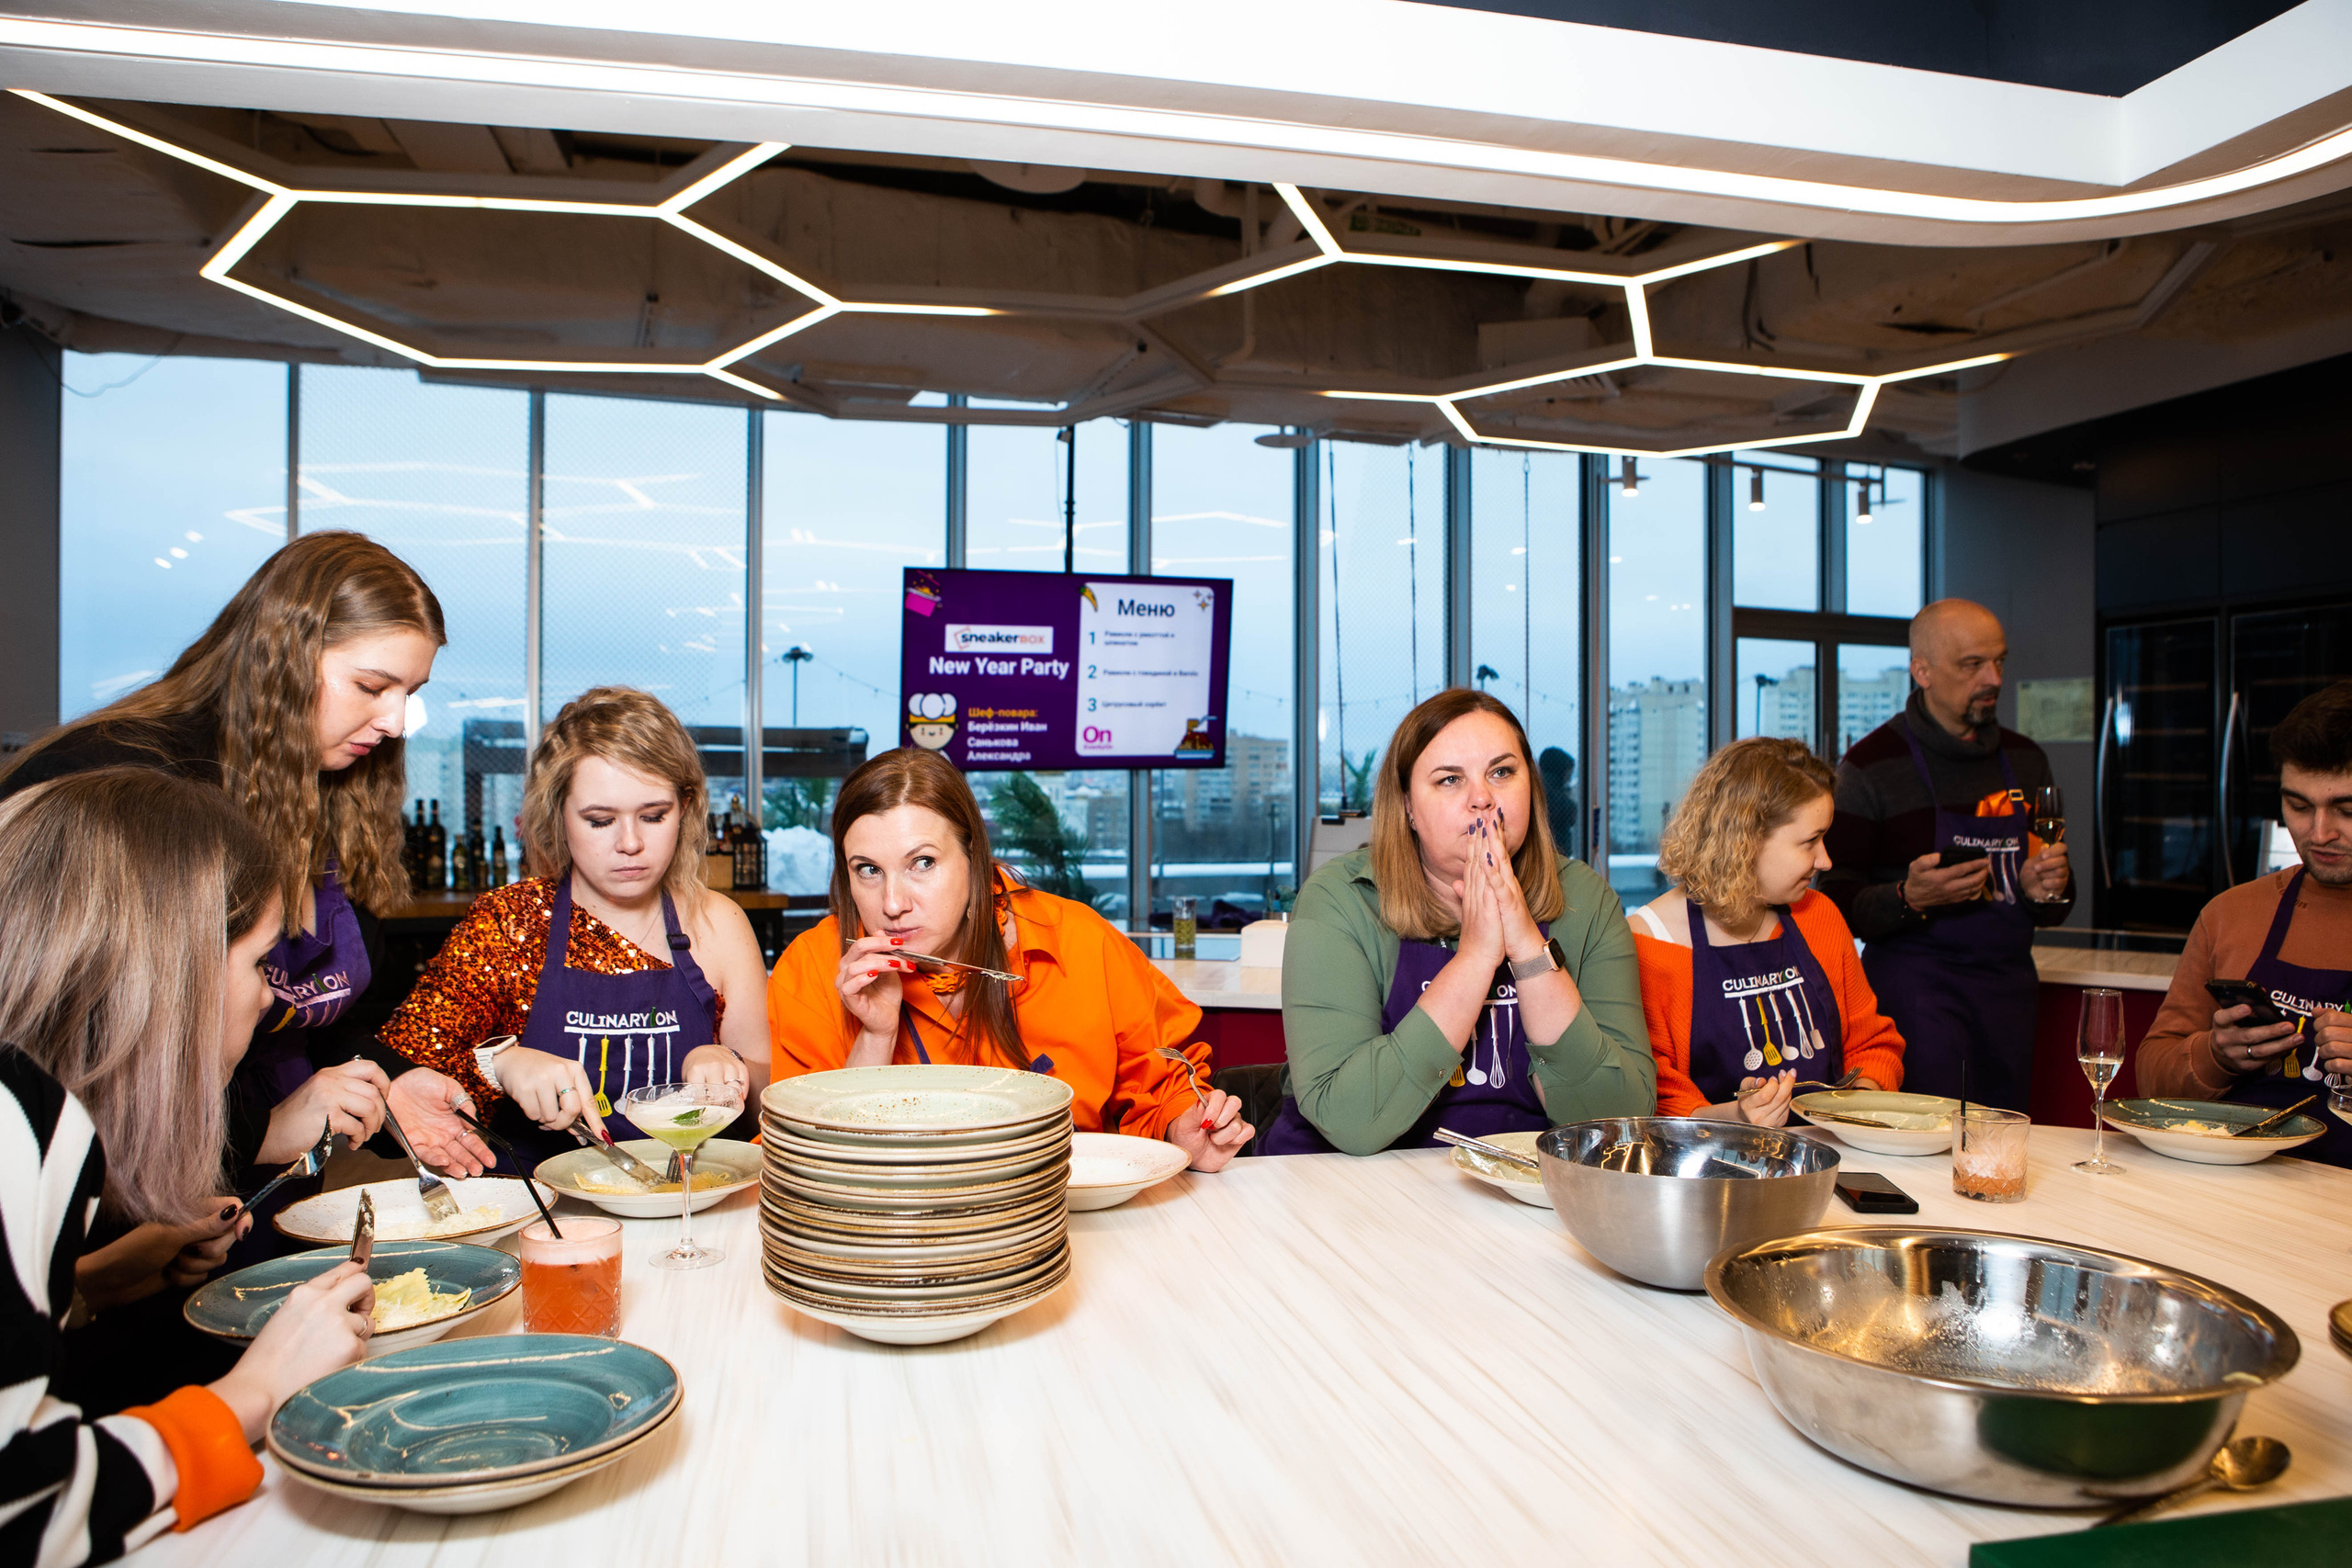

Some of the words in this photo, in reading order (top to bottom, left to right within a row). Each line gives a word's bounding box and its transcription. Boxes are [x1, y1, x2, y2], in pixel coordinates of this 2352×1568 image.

[1117, 599, 1175, 617] Меню
[1089, 631, 1095, 644] 1
[929, 656, 971, 675] New
[975, 657, 1017, 676] Year
[1020, 658, 1069, 680] Party
[1088, 665, 1097, 679] 2
[1088, 697, 1097, 712] 3
[968, 706, 1038, 719] Шеф-повара:
[1020, 721, 1047, 732] Иван
[1082, 726, 1112, 743] On
[967, 750, 1032, 762] Александра
[566, 1010, 650, 1028] CULINARY
[655, 1010, 678, 1025] ON
